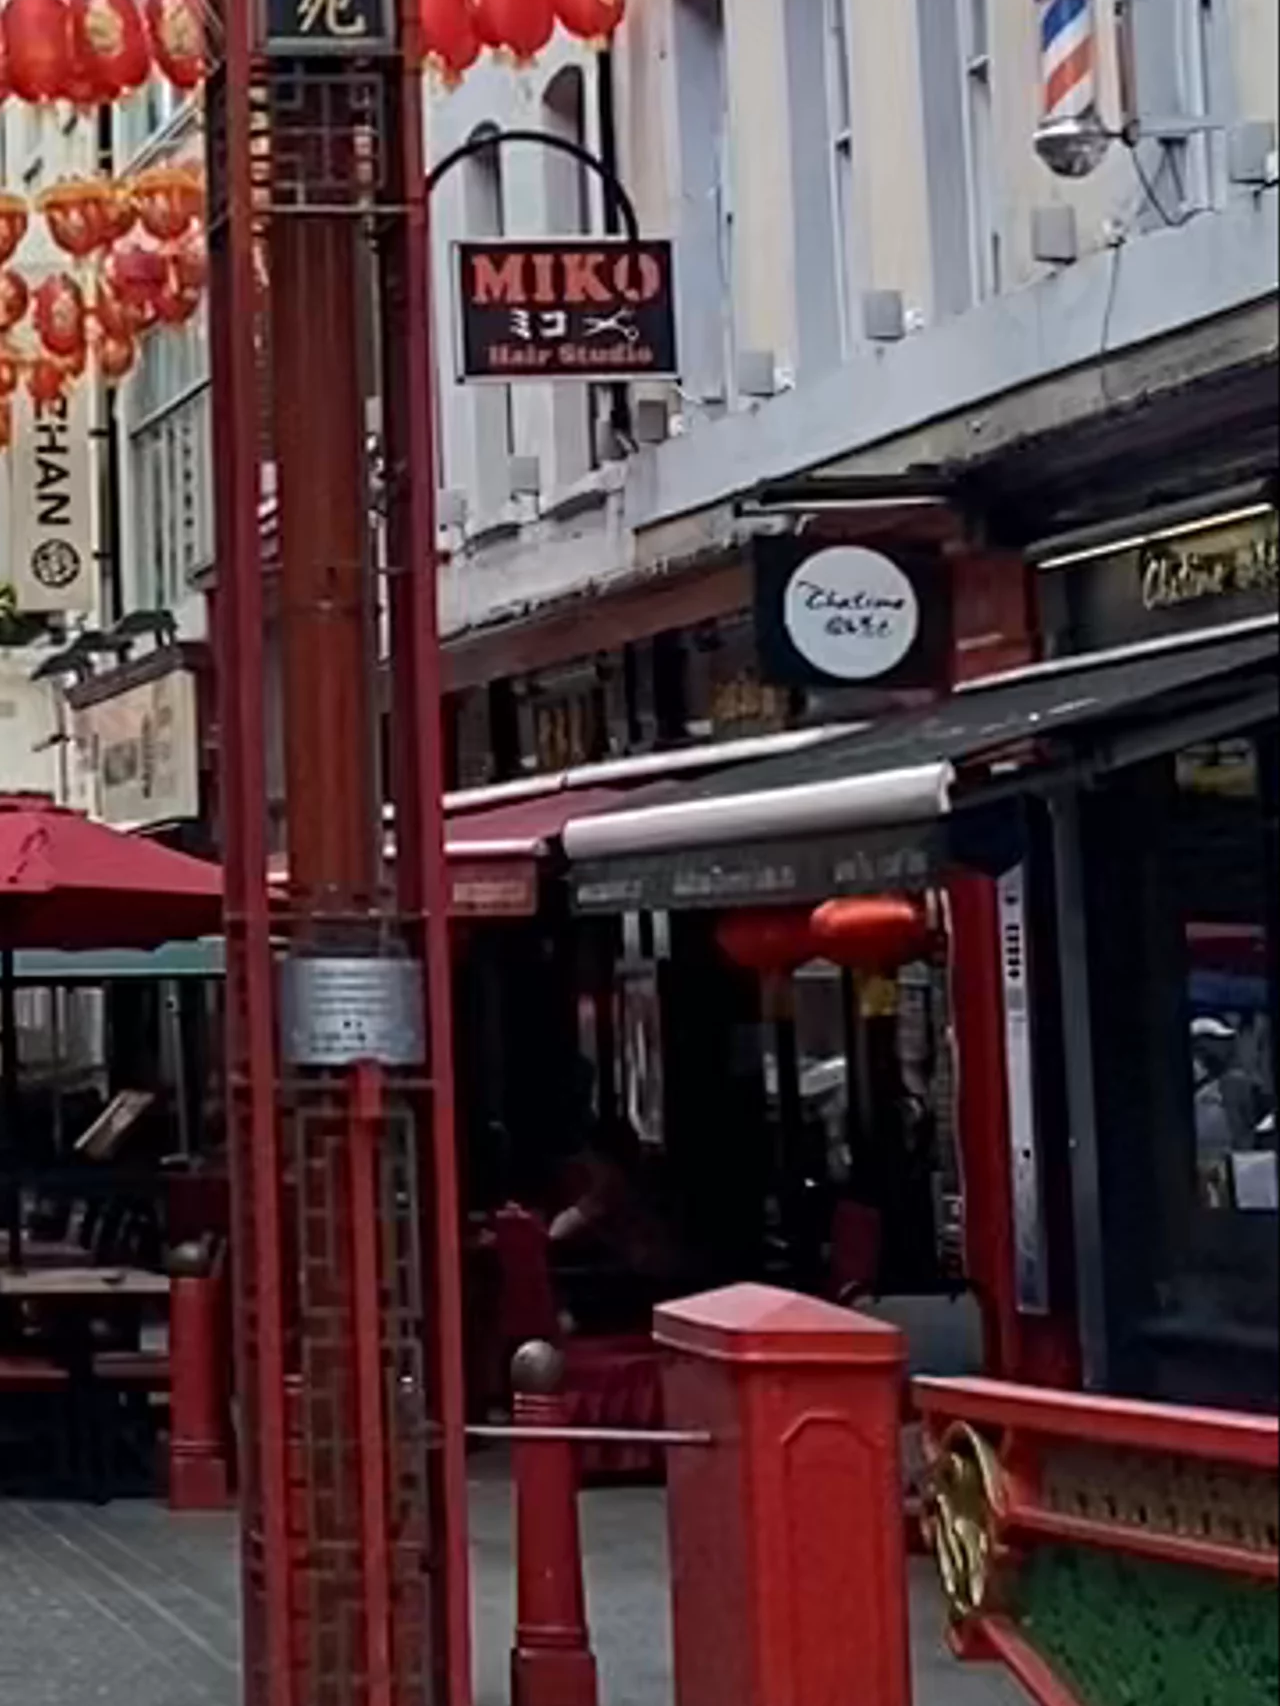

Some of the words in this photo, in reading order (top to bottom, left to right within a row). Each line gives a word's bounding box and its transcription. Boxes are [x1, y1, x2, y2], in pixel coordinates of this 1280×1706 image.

[472, 253, 661, 304] MIKO
[510, 309, 567, 339] ミコ
[487, 344, 553, 366] Hair
[558, 342, 654, 366] Studio
